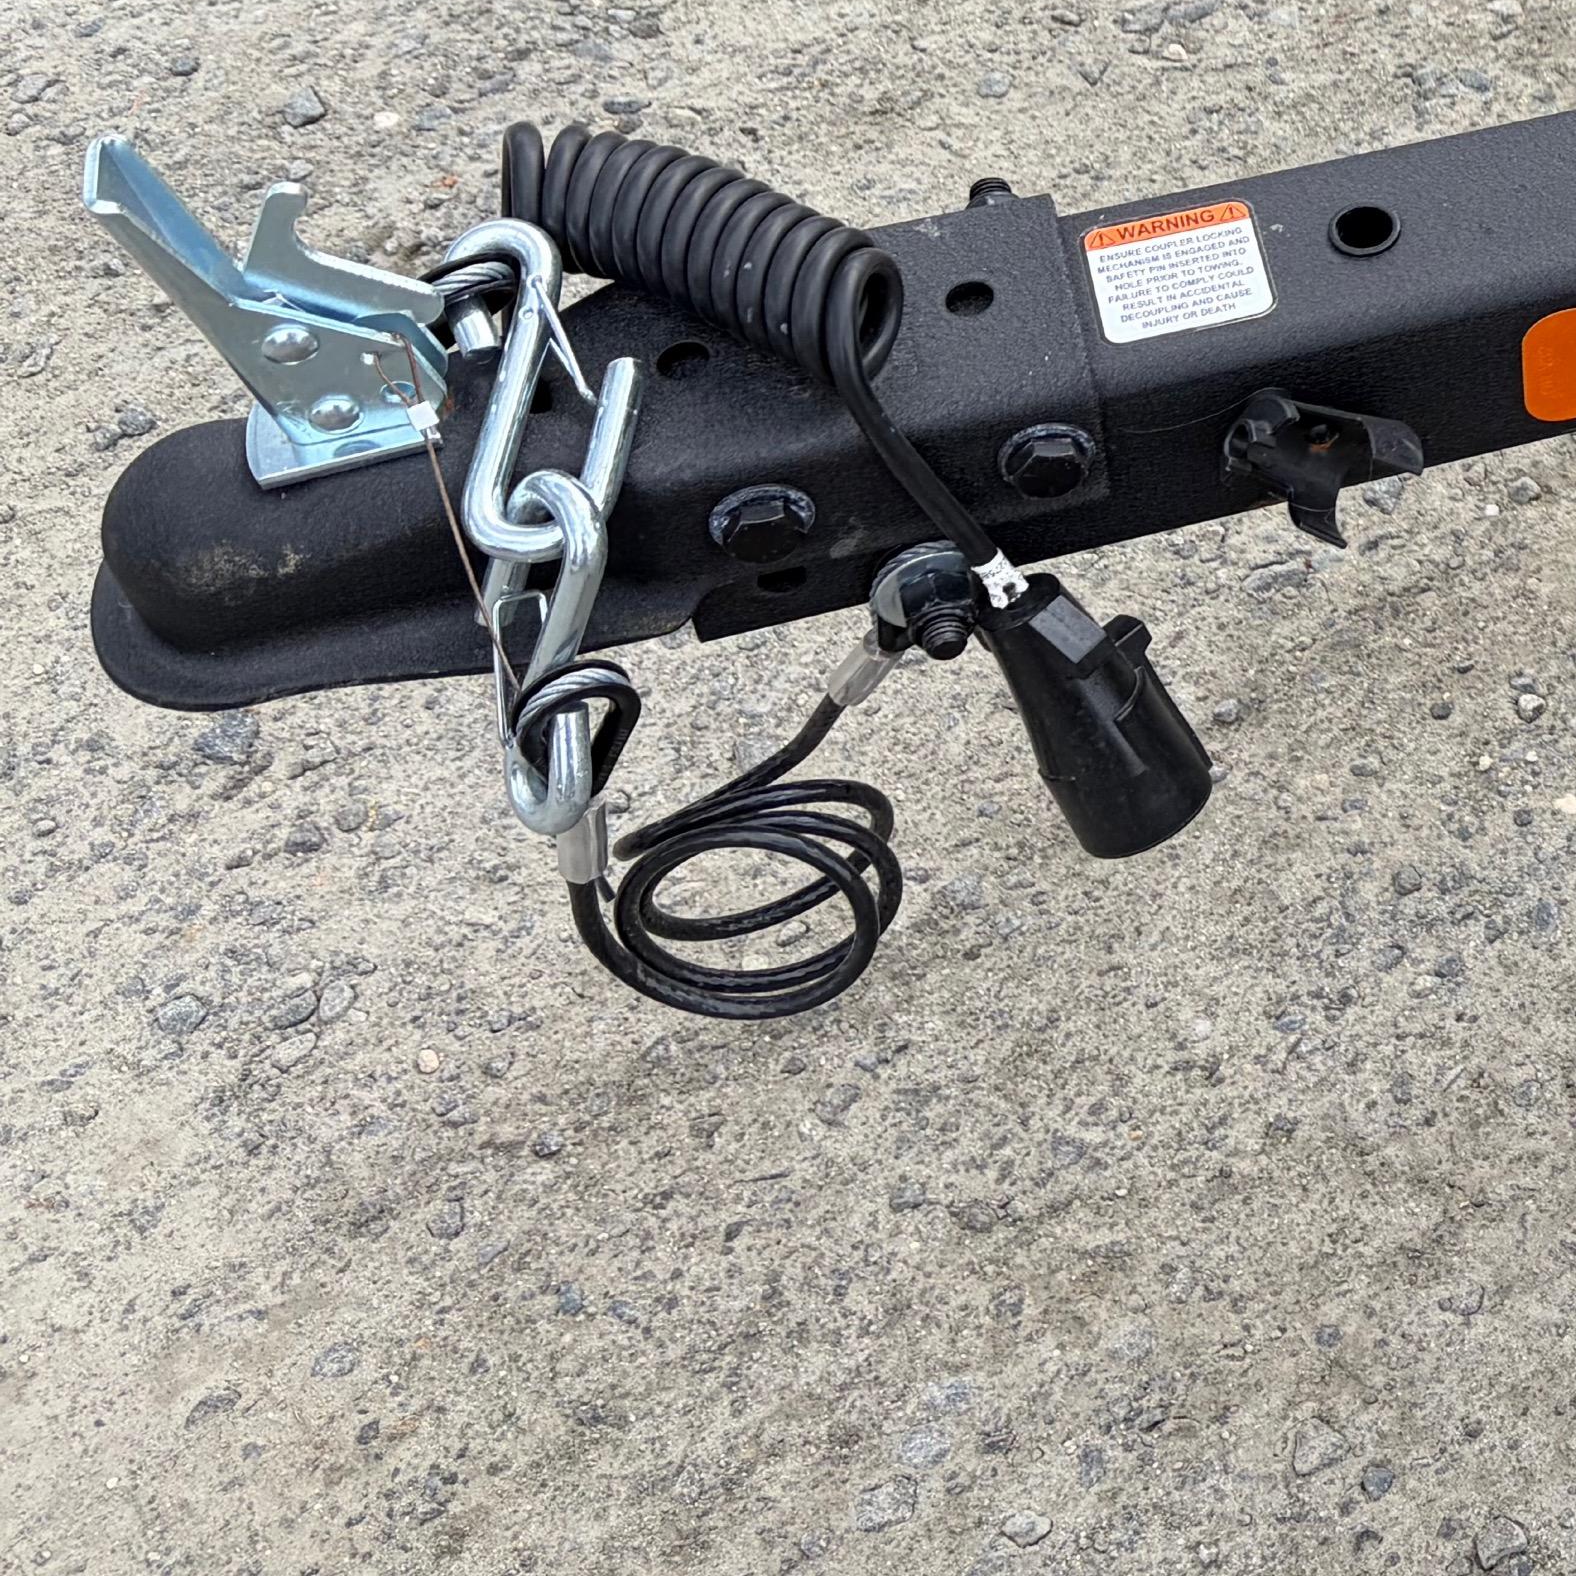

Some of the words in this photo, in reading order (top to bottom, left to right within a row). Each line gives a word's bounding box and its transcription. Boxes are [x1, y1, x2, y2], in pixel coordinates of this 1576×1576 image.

[1116, 210, 1215, 240] WARNING
[1098, 255, 1161, 275] MECHANISM
[1175, 241, 1226, 257] ENGAGED
[1227, 235, 1250, 245] AND
[1099, 248, 1142, 263] ENSURE
[1144, 237, 1194, 253] COUPLER
[1196, 226, 1243, 242] LOCKING
[1106, 269, 1146, 283] SAFETY
[1149, 265, 1166, 273] PIN
[1169, 253, 1220, 269] INSERTED
[1222, 247, 1247, 257] INTO
[1115, 281, 1144, 292] HOLE
[1146, 273, 1179, 284] PRIOR
[1182, 269, 1196, 277] TO
[1108, 289, 1153, 304] FAILURE
[1156, 285, 1170, 293] TO
[1172, 275, 1215, 289] COMPLY
[1217, 266, 1255, 279] COULD
[1123, 297, 1164, 311] RESULT
[1179, 279, 1245, 298] ACCIDENTAL
[1121, 302, 1190, 322] DECOUPLING
[1191, 297, 1214, 306] AND
[1216, 288, 1253, 301] CAUSE
[1142, 316, 1180, 328] INJURY
[1200, 303, 1236, 315] DEATH
